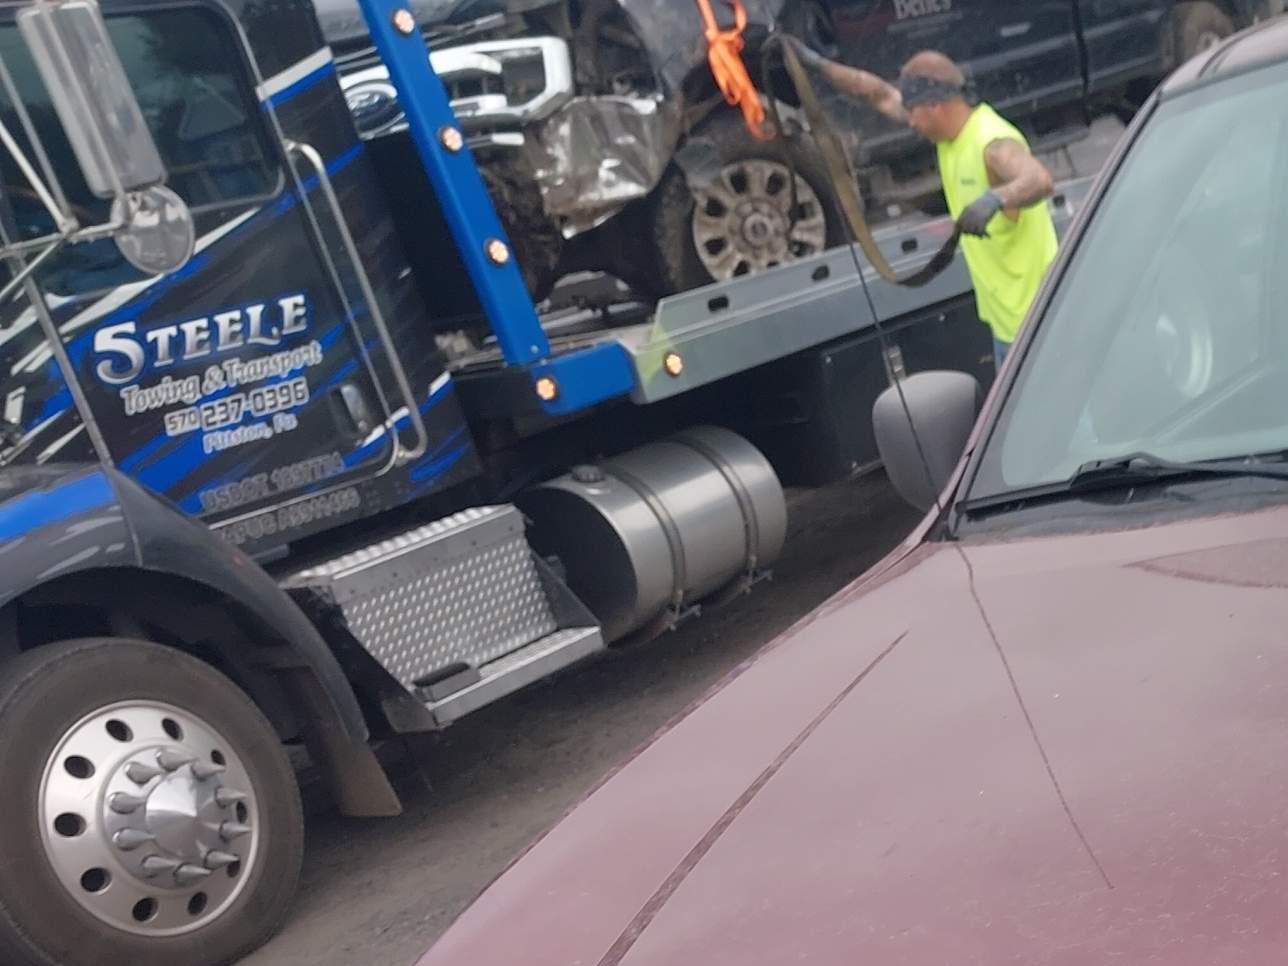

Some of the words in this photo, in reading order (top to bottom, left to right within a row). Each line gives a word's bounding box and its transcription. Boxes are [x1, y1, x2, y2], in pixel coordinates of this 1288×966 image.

[94, 294, 307, 384] STEELE
[120, 375, 202, 416] Towing
[202, 364, 225, 393] &
[223, 340, 323, 388] Transport
[164, 406, 201, 437] 570
[200, 376, 310, 428] 237-0396
